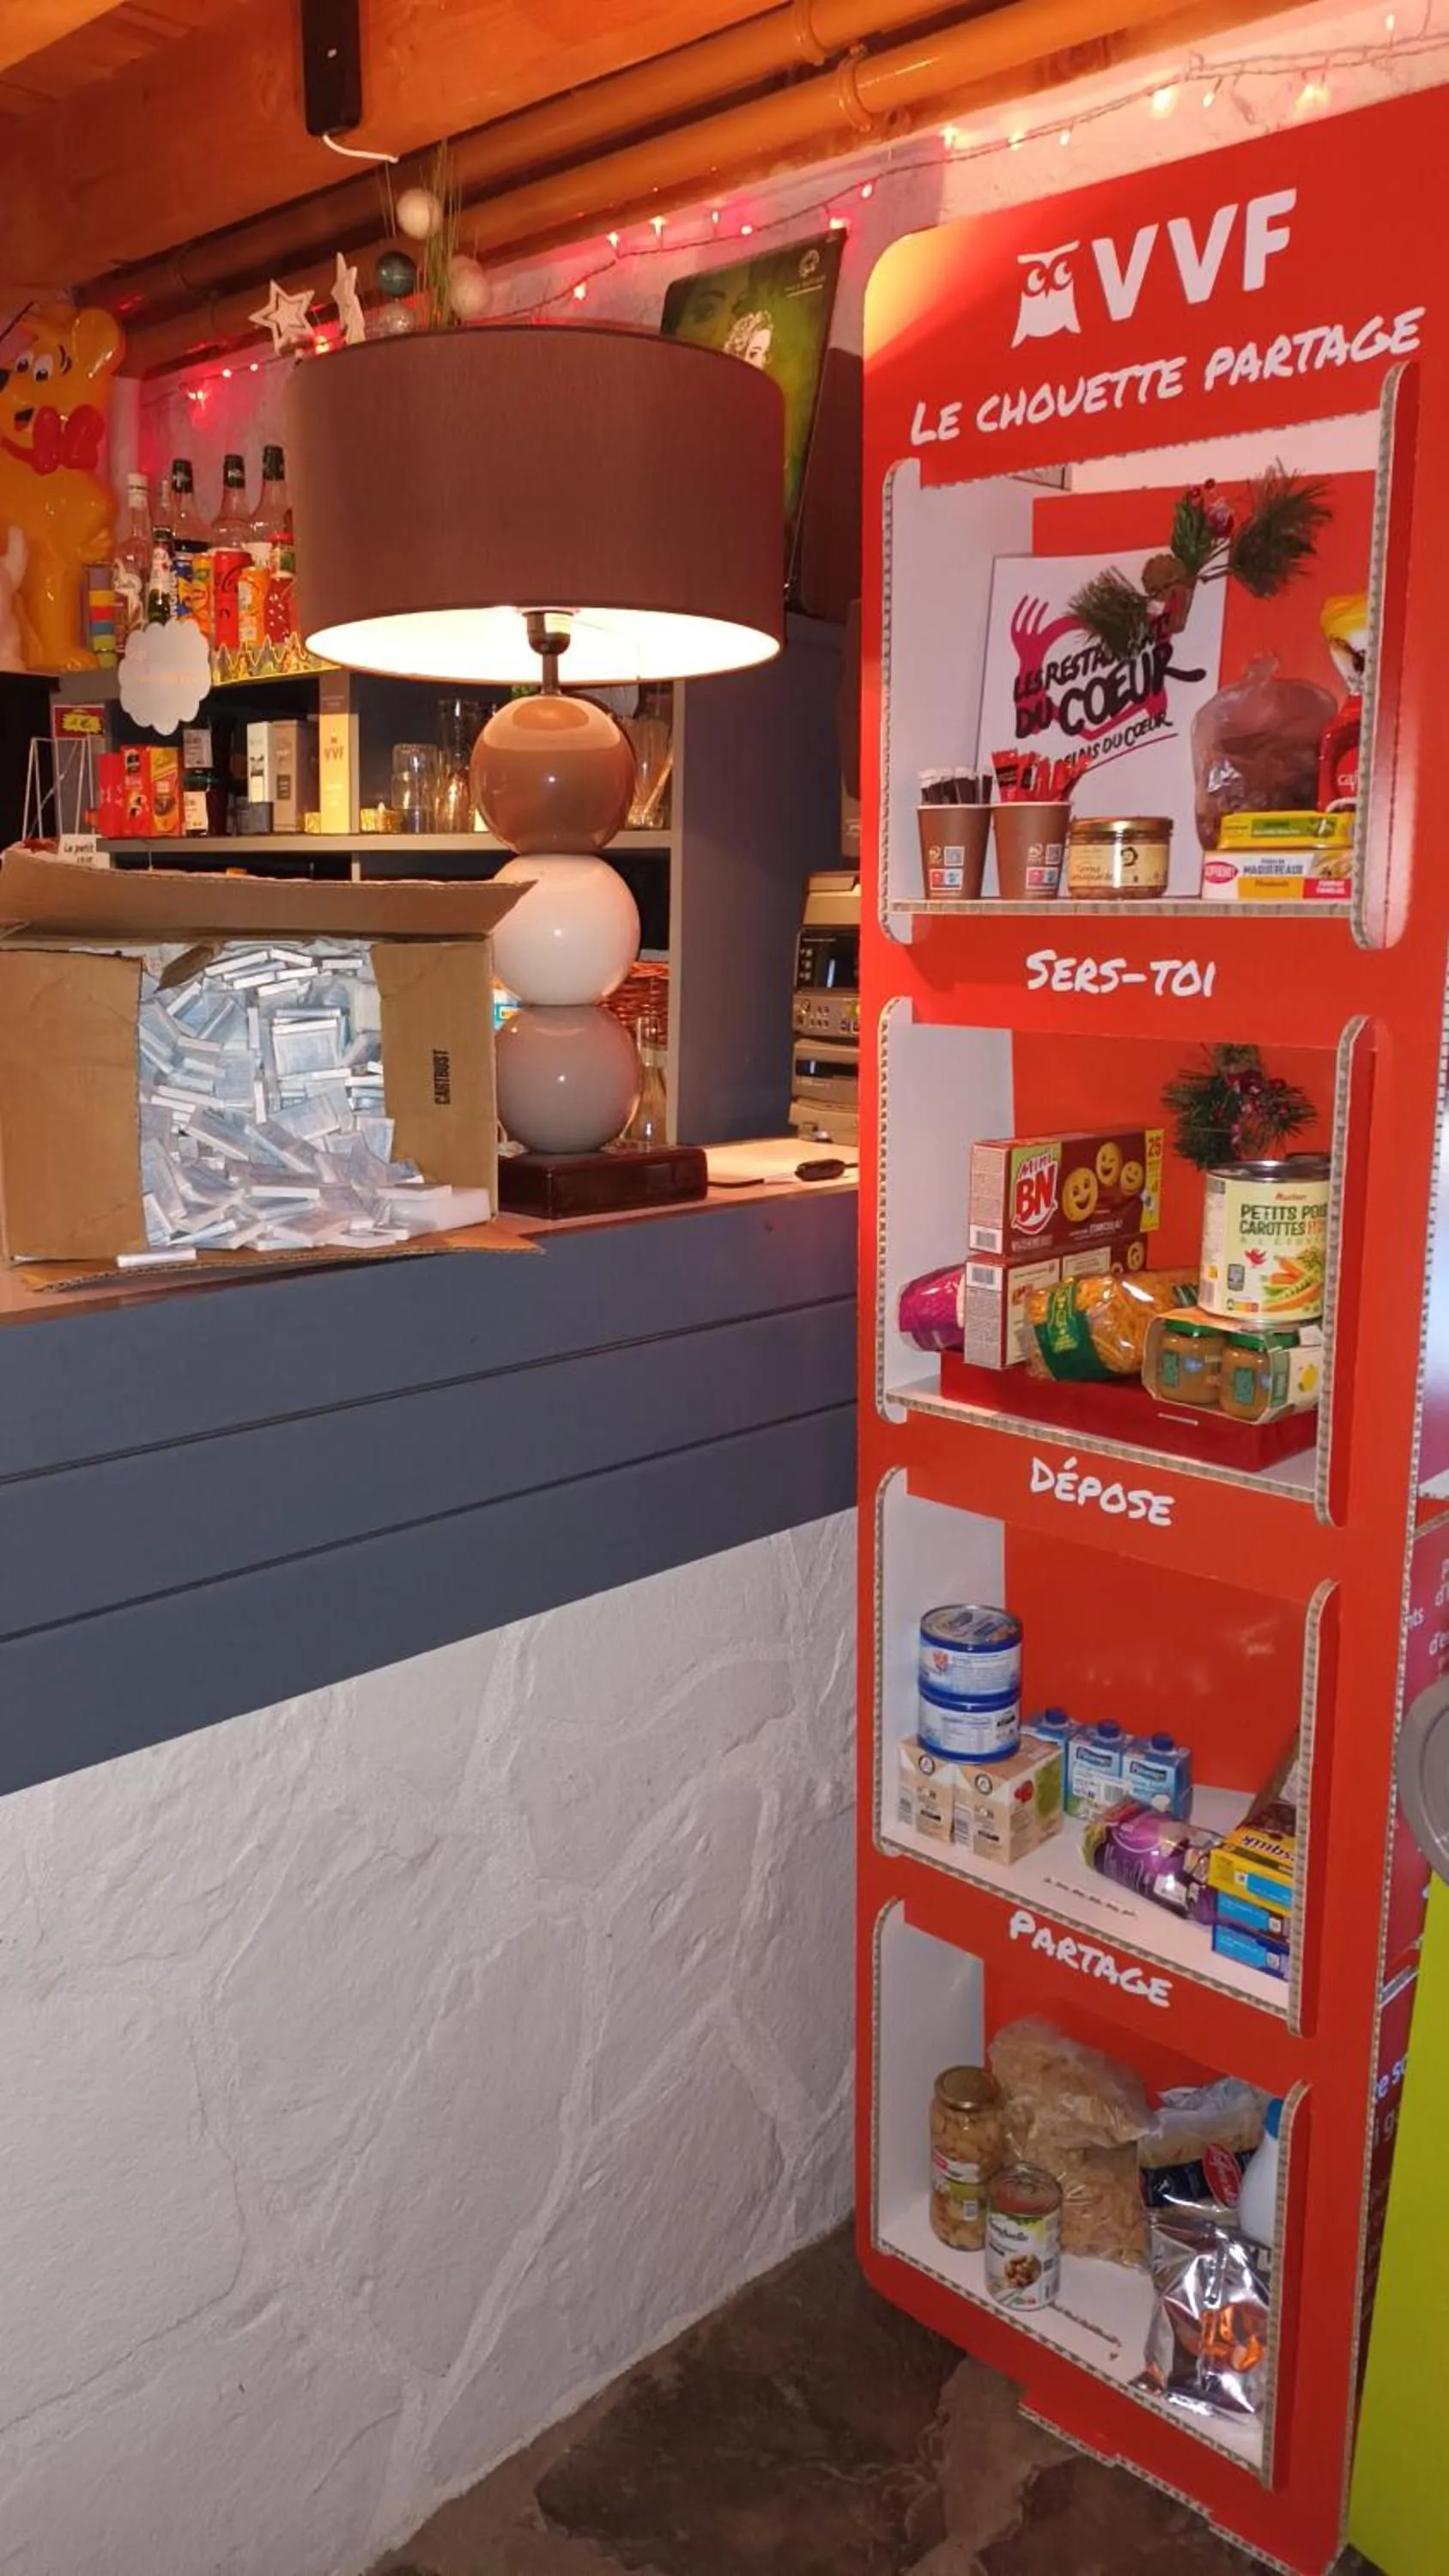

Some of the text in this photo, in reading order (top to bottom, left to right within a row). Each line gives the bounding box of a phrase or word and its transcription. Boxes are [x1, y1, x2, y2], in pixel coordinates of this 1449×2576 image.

[1091, 187, 1297, 321] VVF
[911, 306, 1426, 446] LE CHOUETTE PARTAGE
[1016, 696, 1053, 739] DU
[1102, 731, 1124, 754] DU
[1027, 949, 1217, 999] SERS-TOI
[1016, 1164, 1056, 1224] BN
[1240, 1204, 1297, 1220] PETITS
[1240, 1220, 1305, 1236] CAROTTES
[1030, 1456, 1176, 1526] DÉPOSE
[1009, 1911, 1173, 2008] PARTAGE
